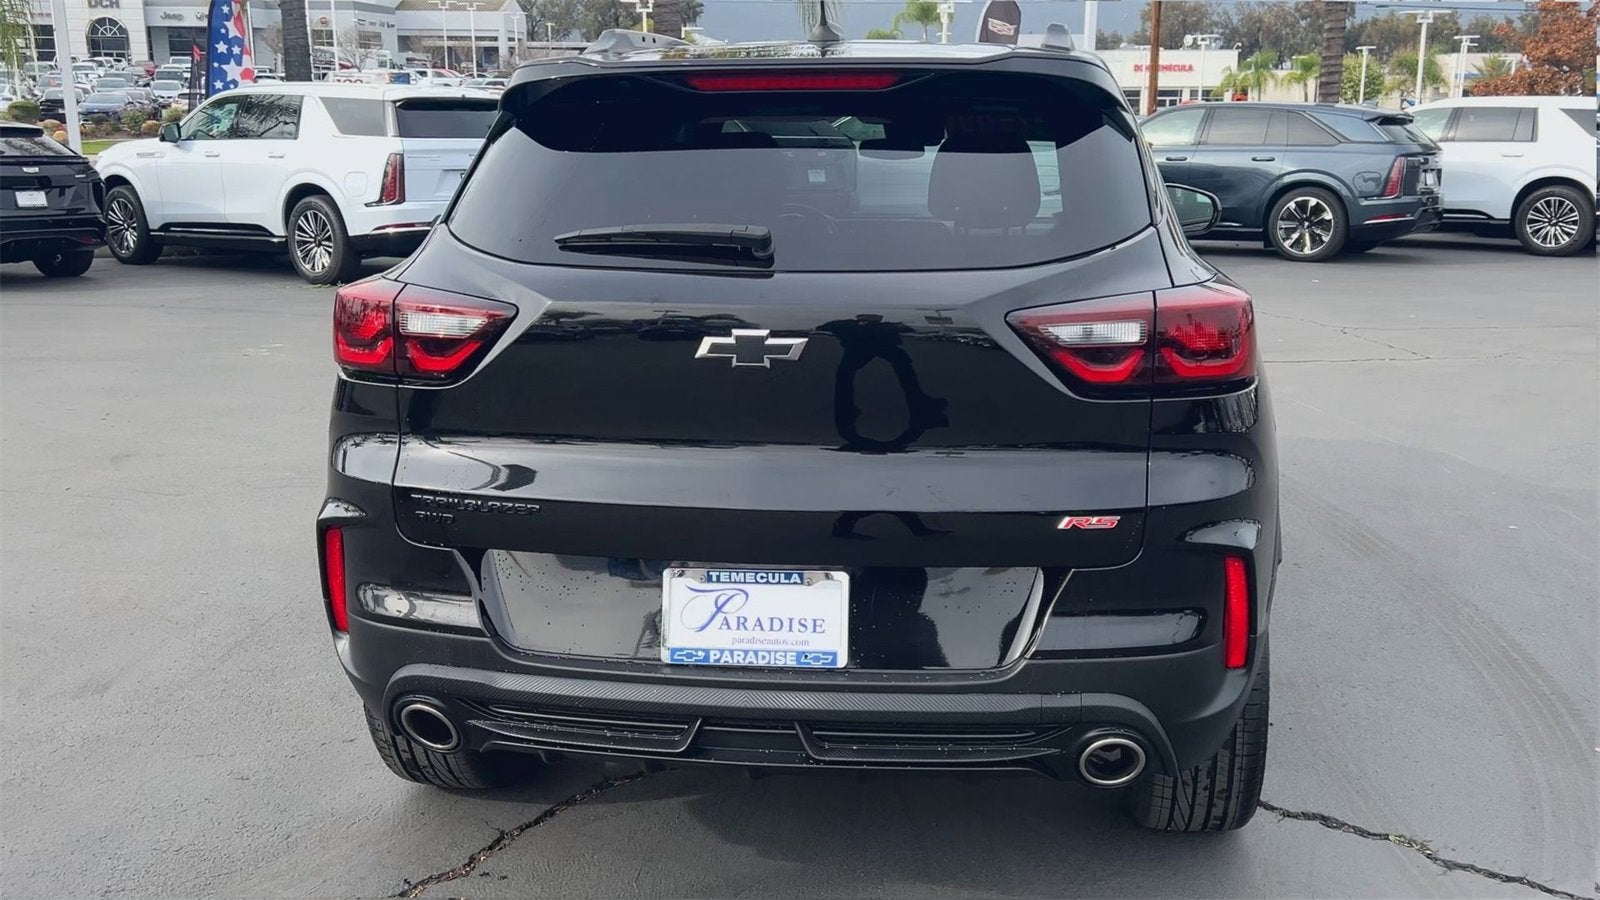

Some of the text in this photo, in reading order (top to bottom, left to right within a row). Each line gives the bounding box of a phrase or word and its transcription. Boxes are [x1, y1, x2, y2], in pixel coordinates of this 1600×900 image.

[1156, 64, 1193, 72] EMECULA
[410, 494, 541, 514] TRAILBLAZER
[1057, 516, 1121, 529] RS
[709, 571, 802, 584] TEMECULA
[731, 635, 810, 647] paradiseautos.com
[709, 650, 797, 665] PARADISE
